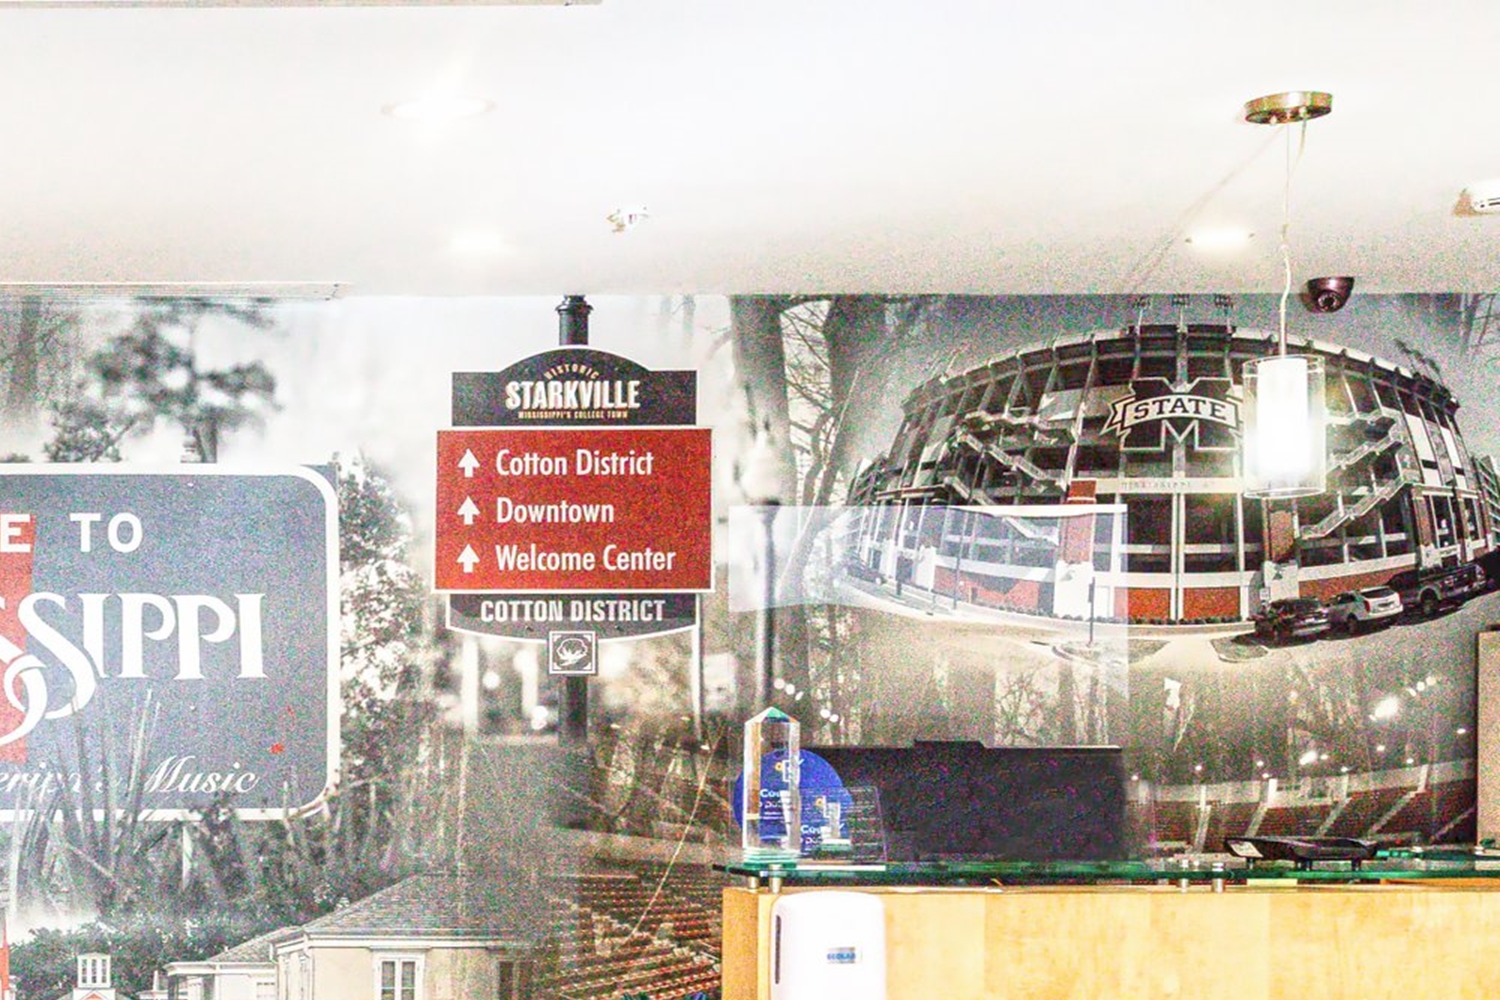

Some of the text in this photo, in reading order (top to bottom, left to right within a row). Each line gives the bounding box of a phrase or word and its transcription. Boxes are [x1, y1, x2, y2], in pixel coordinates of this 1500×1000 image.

[543, 363, 600, 380] HISTORIC
[505, 380, 641, 410] STARKVILLE
[574, 410, 604, 419] COLLEGE
[1133, 397, 1227, 420] STATE
[495, 449, 654, 476] Cotton District
[496, 497, 614, 523] Downtown
[69, 512, 144, 554] TO
[495, 543, 676, 571] Welcome Center
[480, 600, 666, 622] COTTON DISTRICT
[143, 754, 260, 794] Music
